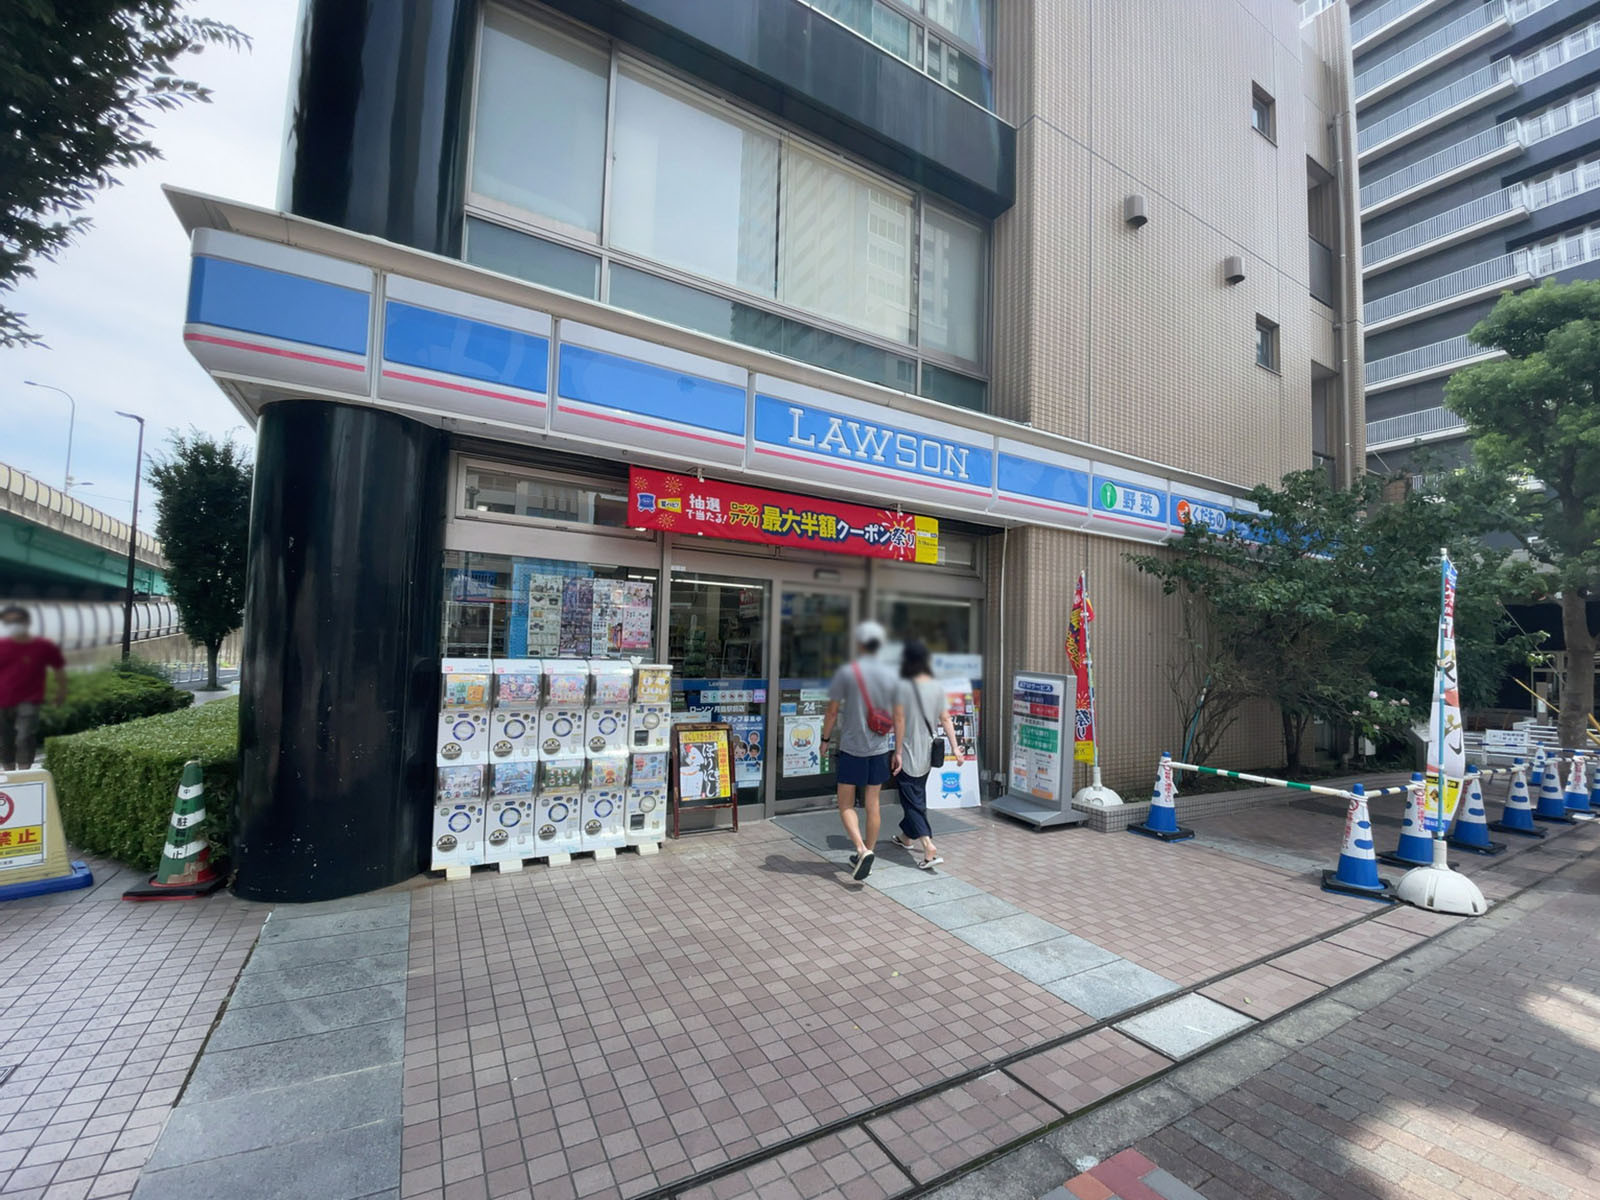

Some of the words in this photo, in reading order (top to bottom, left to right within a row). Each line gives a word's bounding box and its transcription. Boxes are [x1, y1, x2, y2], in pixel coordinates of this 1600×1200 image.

[788, 406, 970, 480] LAWSON
[689, 493, 720, 512] 抽選
[1122, 489, 1154, 515] 野菜
[729, 511, 760, 529] アプリ
[1192, 506, 1224, 529] くだもの
[702, 743, 718, 797] ほりにし
